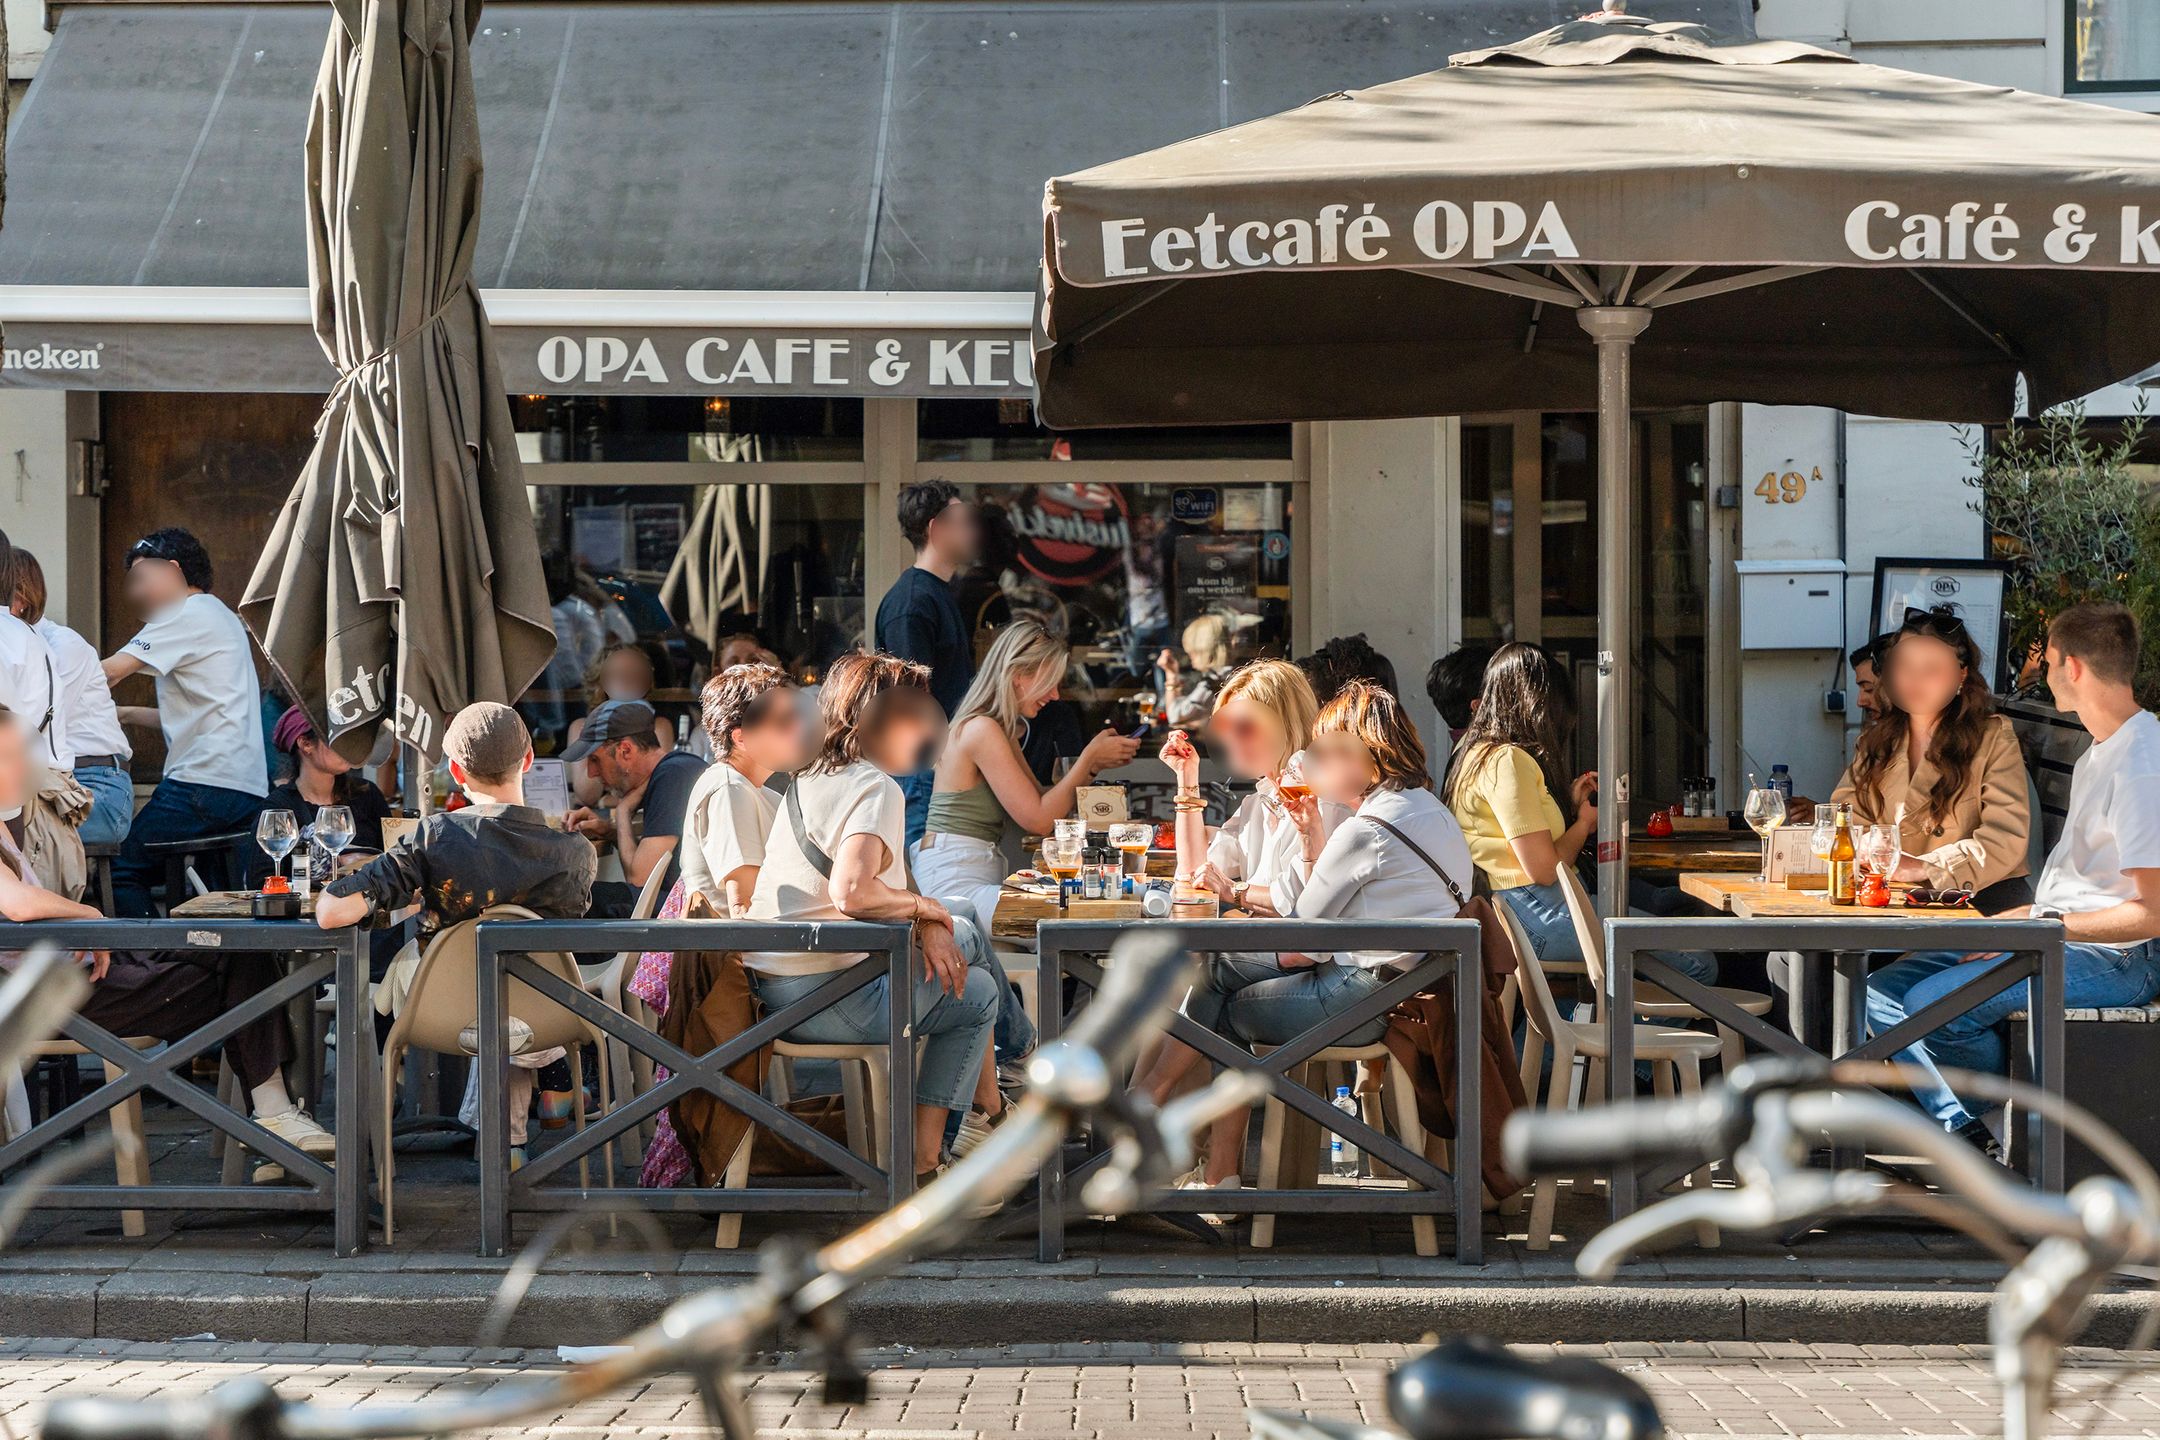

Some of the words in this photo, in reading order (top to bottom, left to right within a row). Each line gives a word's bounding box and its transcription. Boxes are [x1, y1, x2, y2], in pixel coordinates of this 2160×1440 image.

[1101, 203, 1391, 277] Eetcafé
[1413, 200, 1580, 259] OPA
[1844, 200, 2020, 261] Café
[2043, 203, 2098, 263] &
[537, 335, 669, 383] OPA
[686, 337, 850, 386] CAFE
[868, 338, 911, 386] &
[1754, 471, 1807, 504] 49
[1190, 501, 1215, 511] WIFI
[1196, 576, 1220, 586] Kom
[1221, 576, 1234, 587] bij
[1206, 585, 1247, 595] werken!
[1935, 581, 1956, 593] OPA
